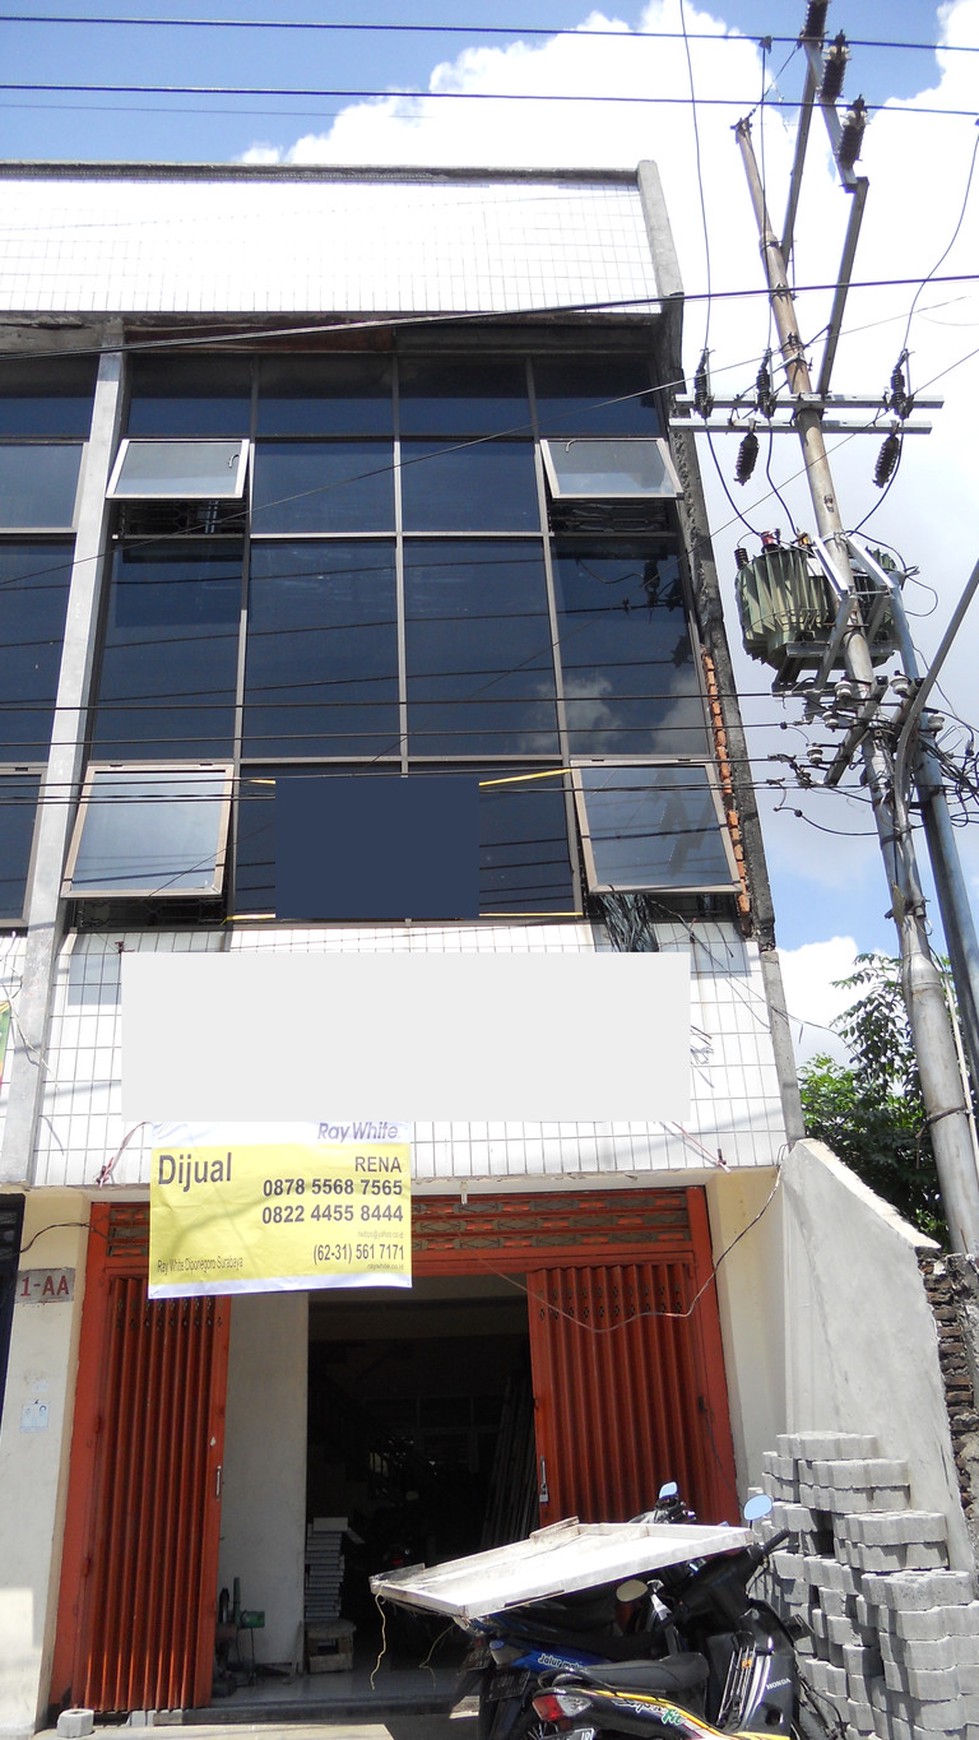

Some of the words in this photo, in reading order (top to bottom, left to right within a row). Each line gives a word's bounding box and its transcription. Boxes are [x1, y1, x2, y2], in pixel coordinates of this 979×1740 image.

[317, 1122, 351, 1144] Ray
[352, 1121, 399, 1140] White
[158, 1152, 232, 1193] Dijual
[355, 1156, 402, 1173] RENA
[263, 1178, 305, 1197] 0878
[311, 1178, 354, 1195] 5568
[360, 1179, 403, 1196] 7565
[262, 1205, 305, 1224] 0822
[310, 1204, 354, 1221] 4455
[360, 1204, 403, 1222] 8444
[313, 1243, 352, 1265] (62-31)
[355, 1243, 375, 1260] 561
[379, 1243, 404, 1261] 7171
[157, 1259, 168, 1276] Ray
[20, 1275, 69, 1297] 1-AA
[765, 1677, 792, 1690] HONDA
